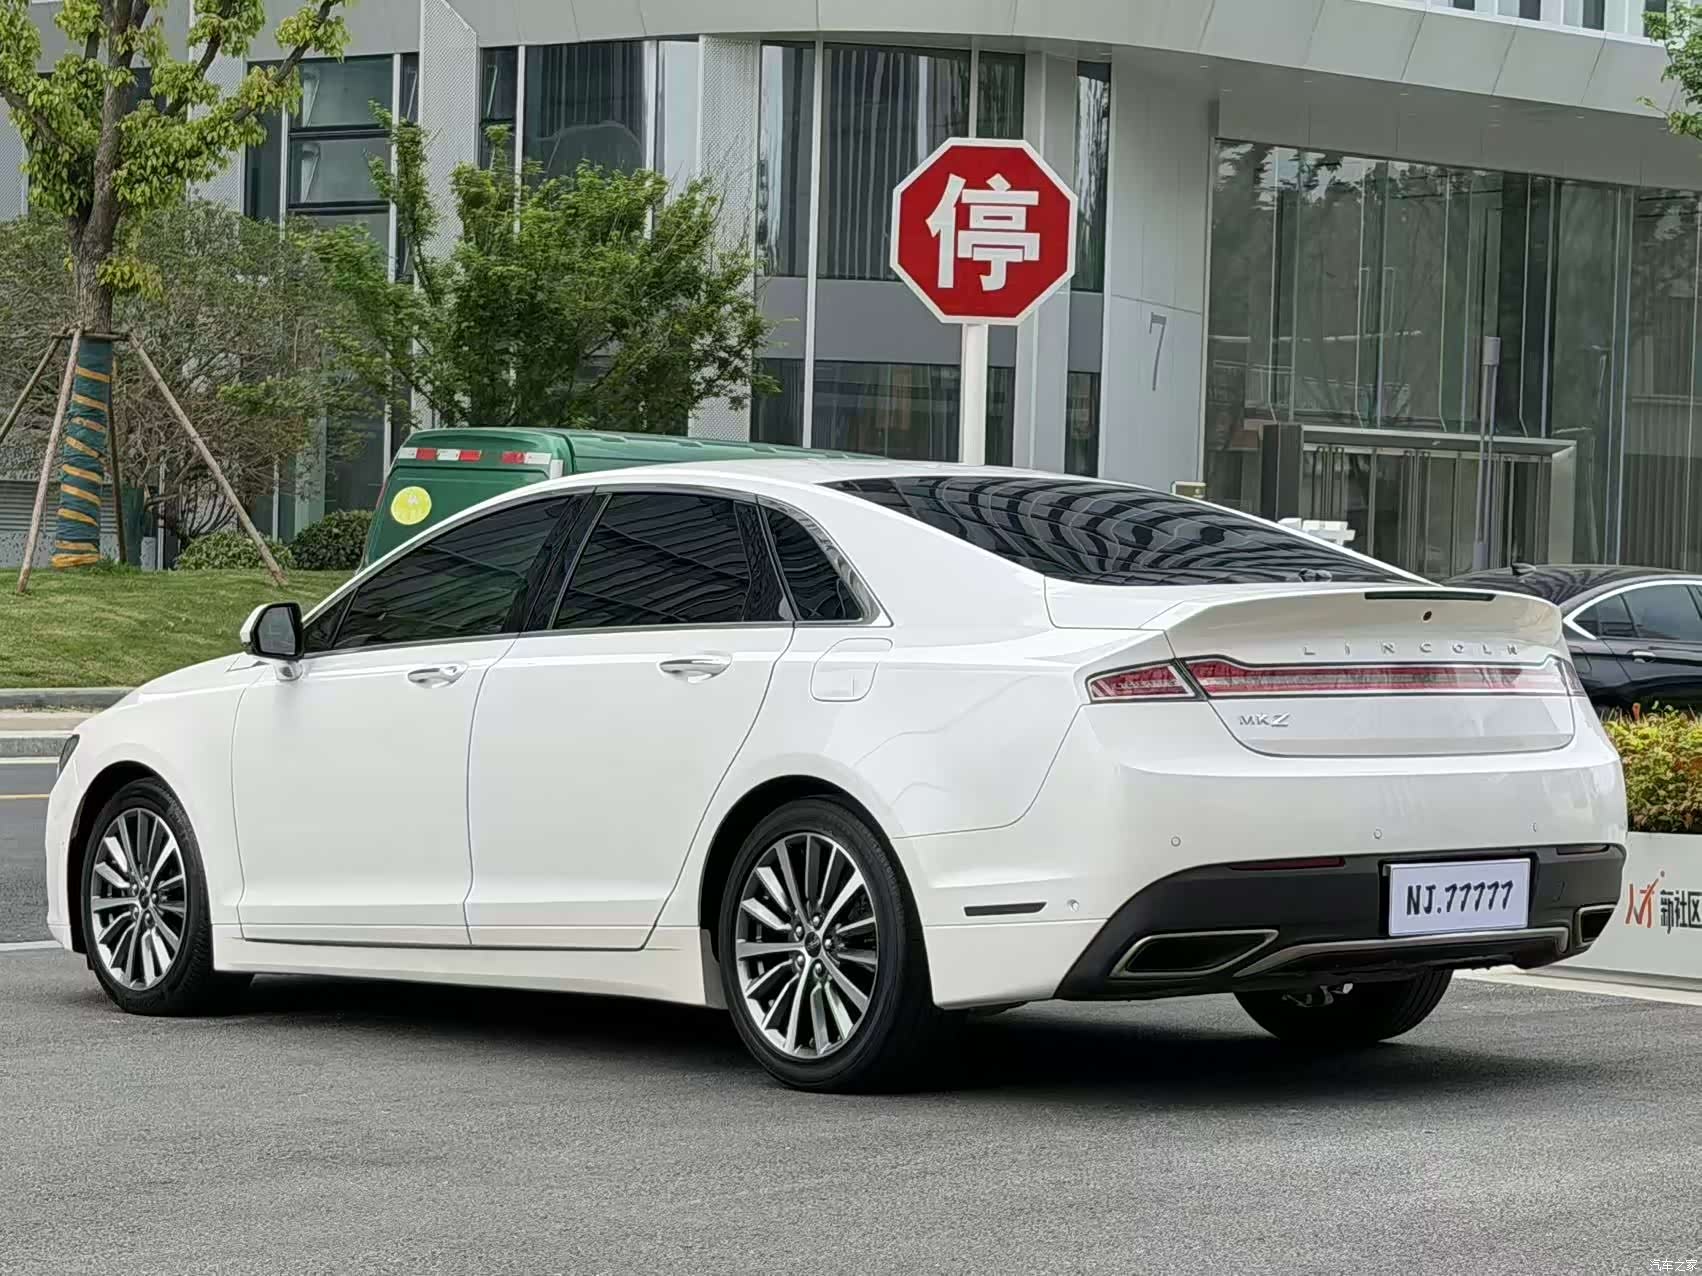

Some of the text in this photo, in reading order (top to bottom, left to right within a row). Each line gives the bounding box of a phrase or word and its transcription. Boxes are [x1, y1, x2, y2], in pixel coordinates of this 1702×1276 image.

[925, 173, 1040, 292] 停
[1149, 312, 1167, 391] 7
[1303, 642, 1518, 656] LINCOLN
[1240, 712, 1290, 727] MKZ
[1406, 880, 1514, 916] NJ.77777
